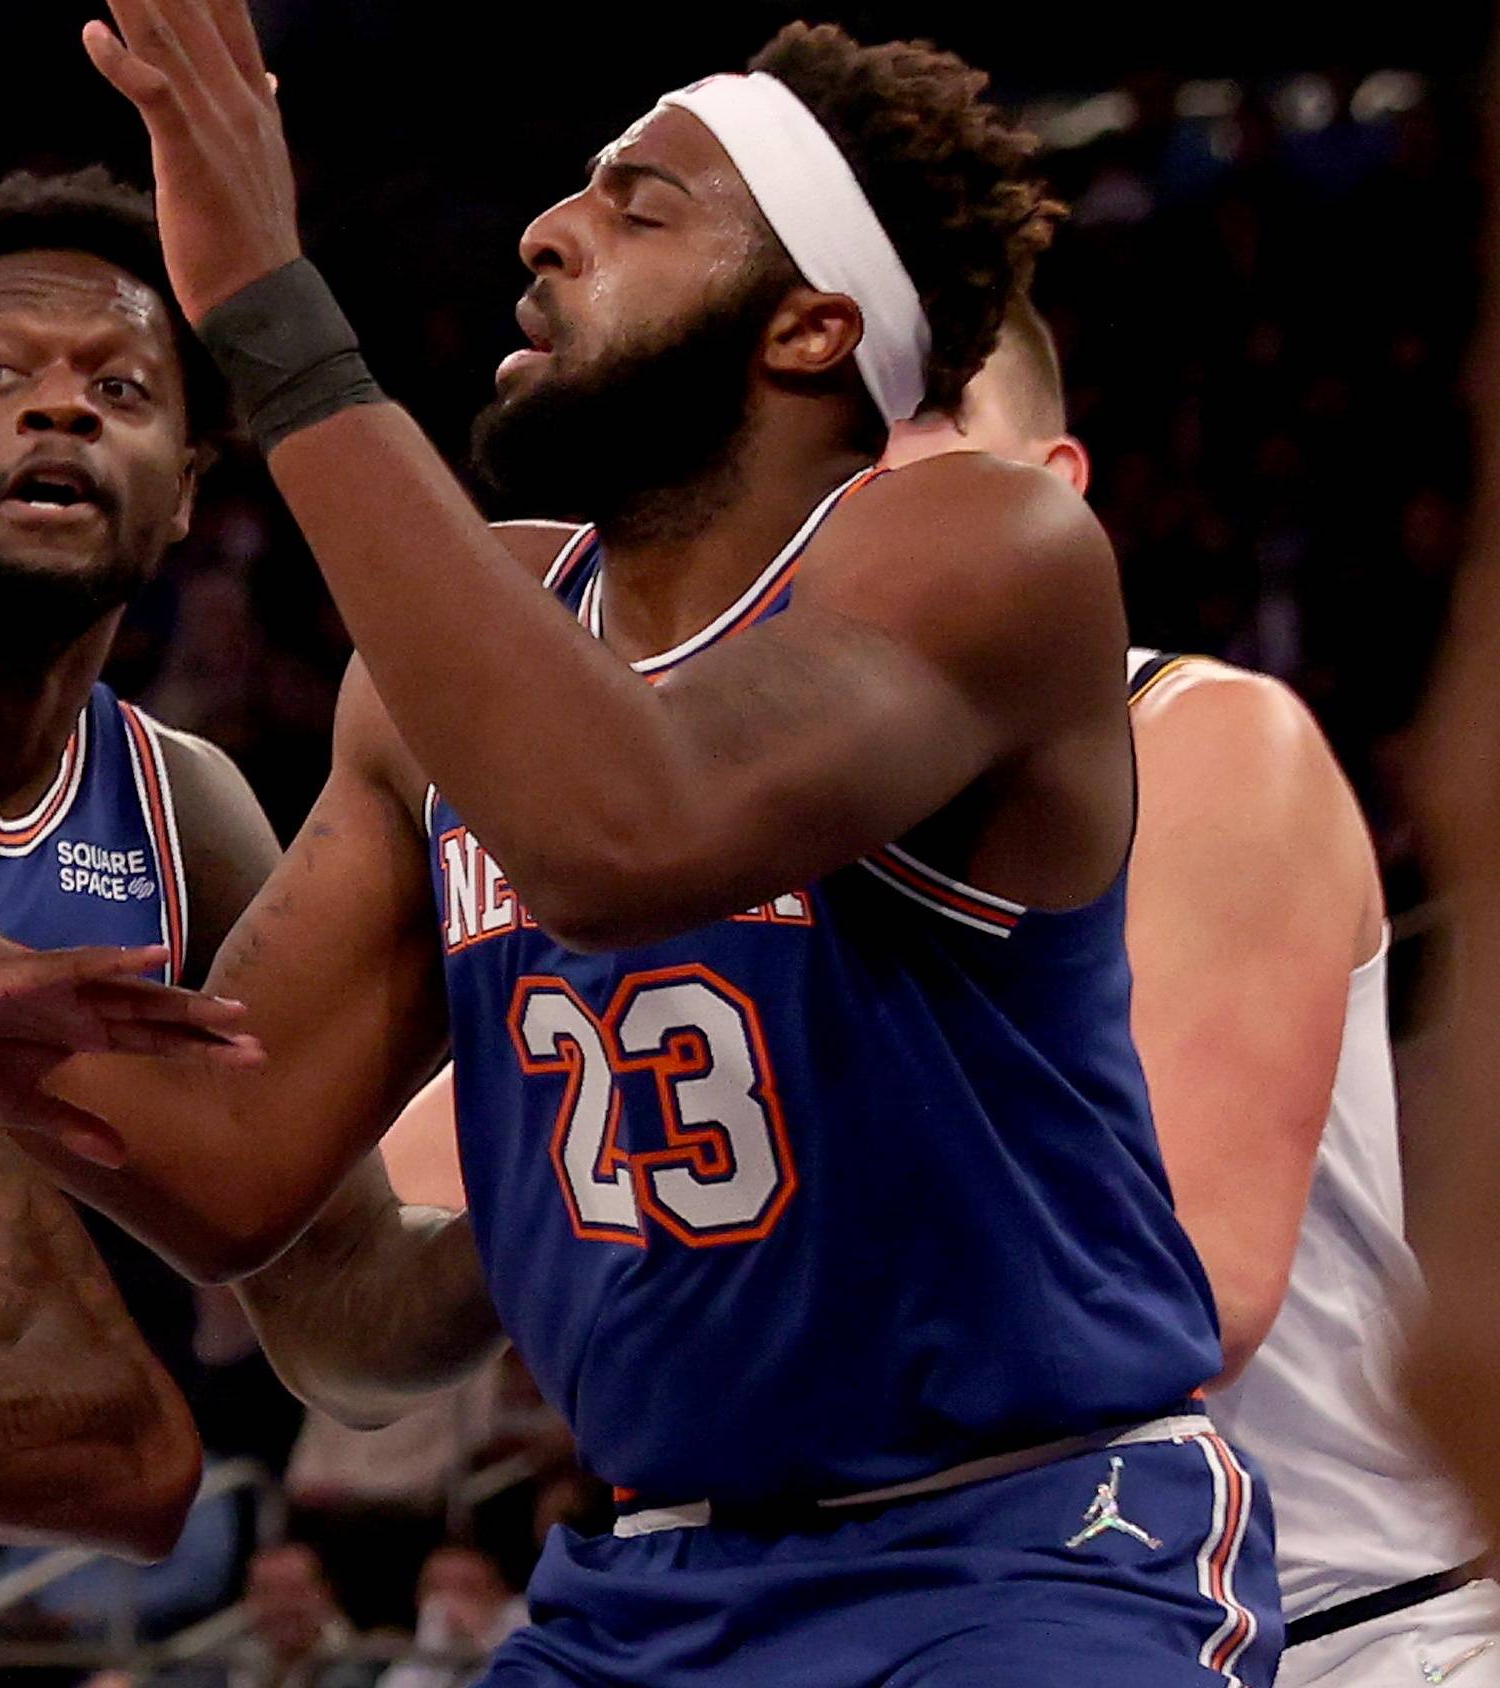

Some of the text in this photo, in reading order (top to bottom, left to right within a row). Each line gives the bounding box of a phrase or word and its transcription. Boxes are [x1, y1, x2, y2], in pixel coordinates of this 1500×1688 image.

[57, 841, 147, 875] SQUARE
[60, 867, 128, 901] SPACE
[506, 962, 798, 1249] 23
